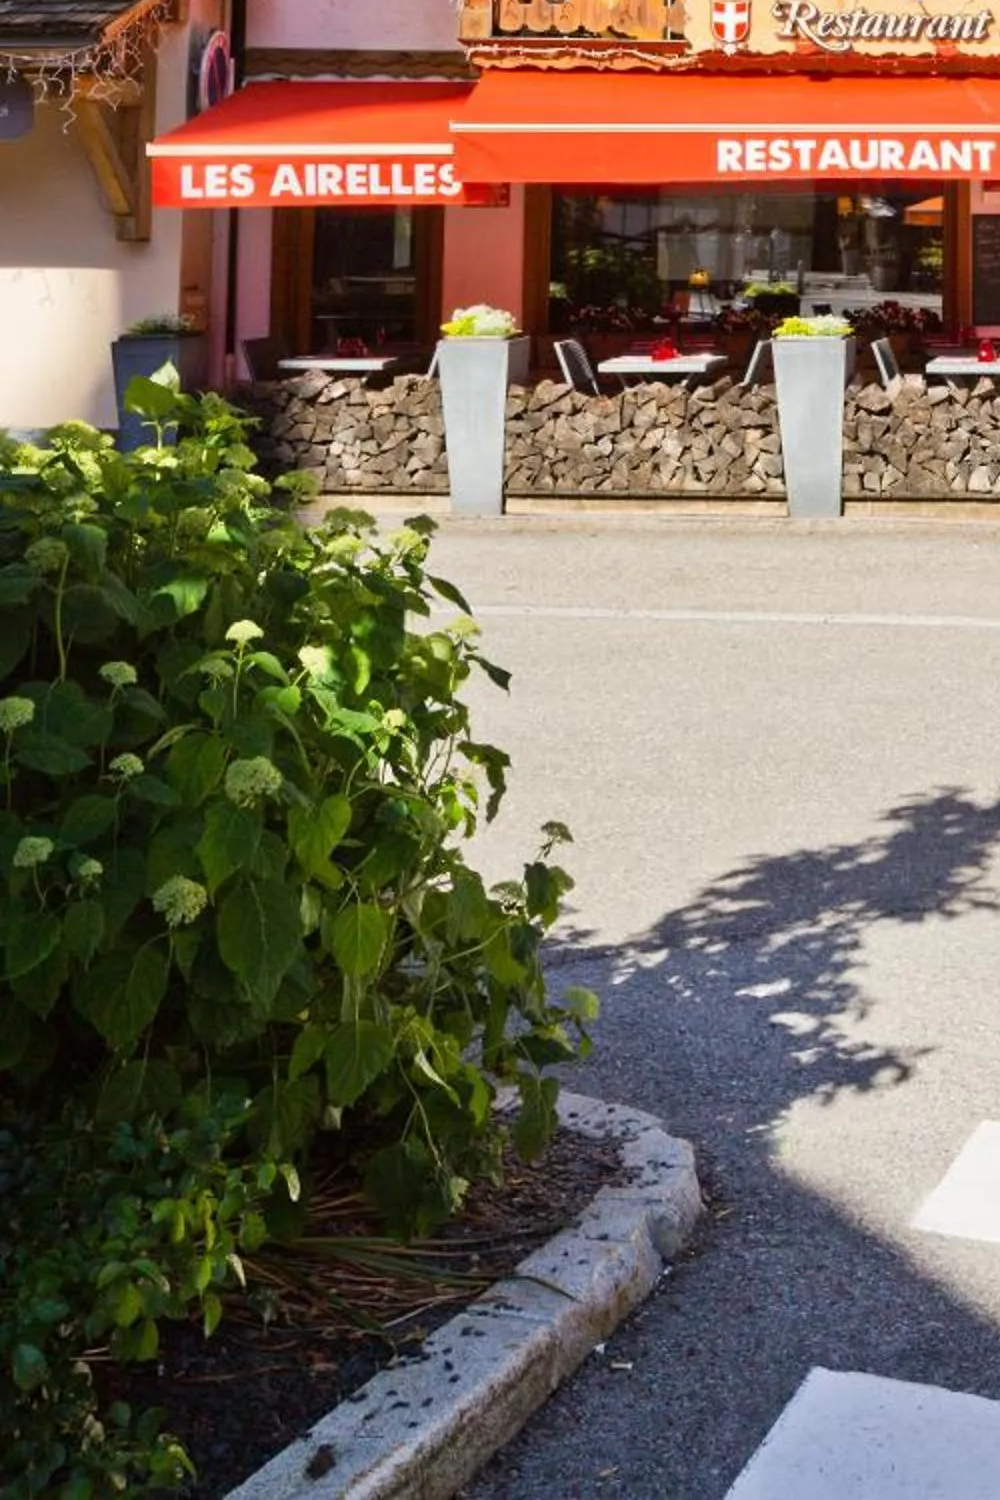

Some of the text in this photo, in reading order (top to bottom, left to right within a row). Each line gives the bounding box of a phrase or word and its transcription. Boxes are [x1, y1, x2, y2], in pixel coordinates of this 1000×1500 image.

[771, 0, 992, 52] Restaurant
[716, 139, 996, 173] RESTAURANT
[181, 163, 462, 198] LES AIRELLES
